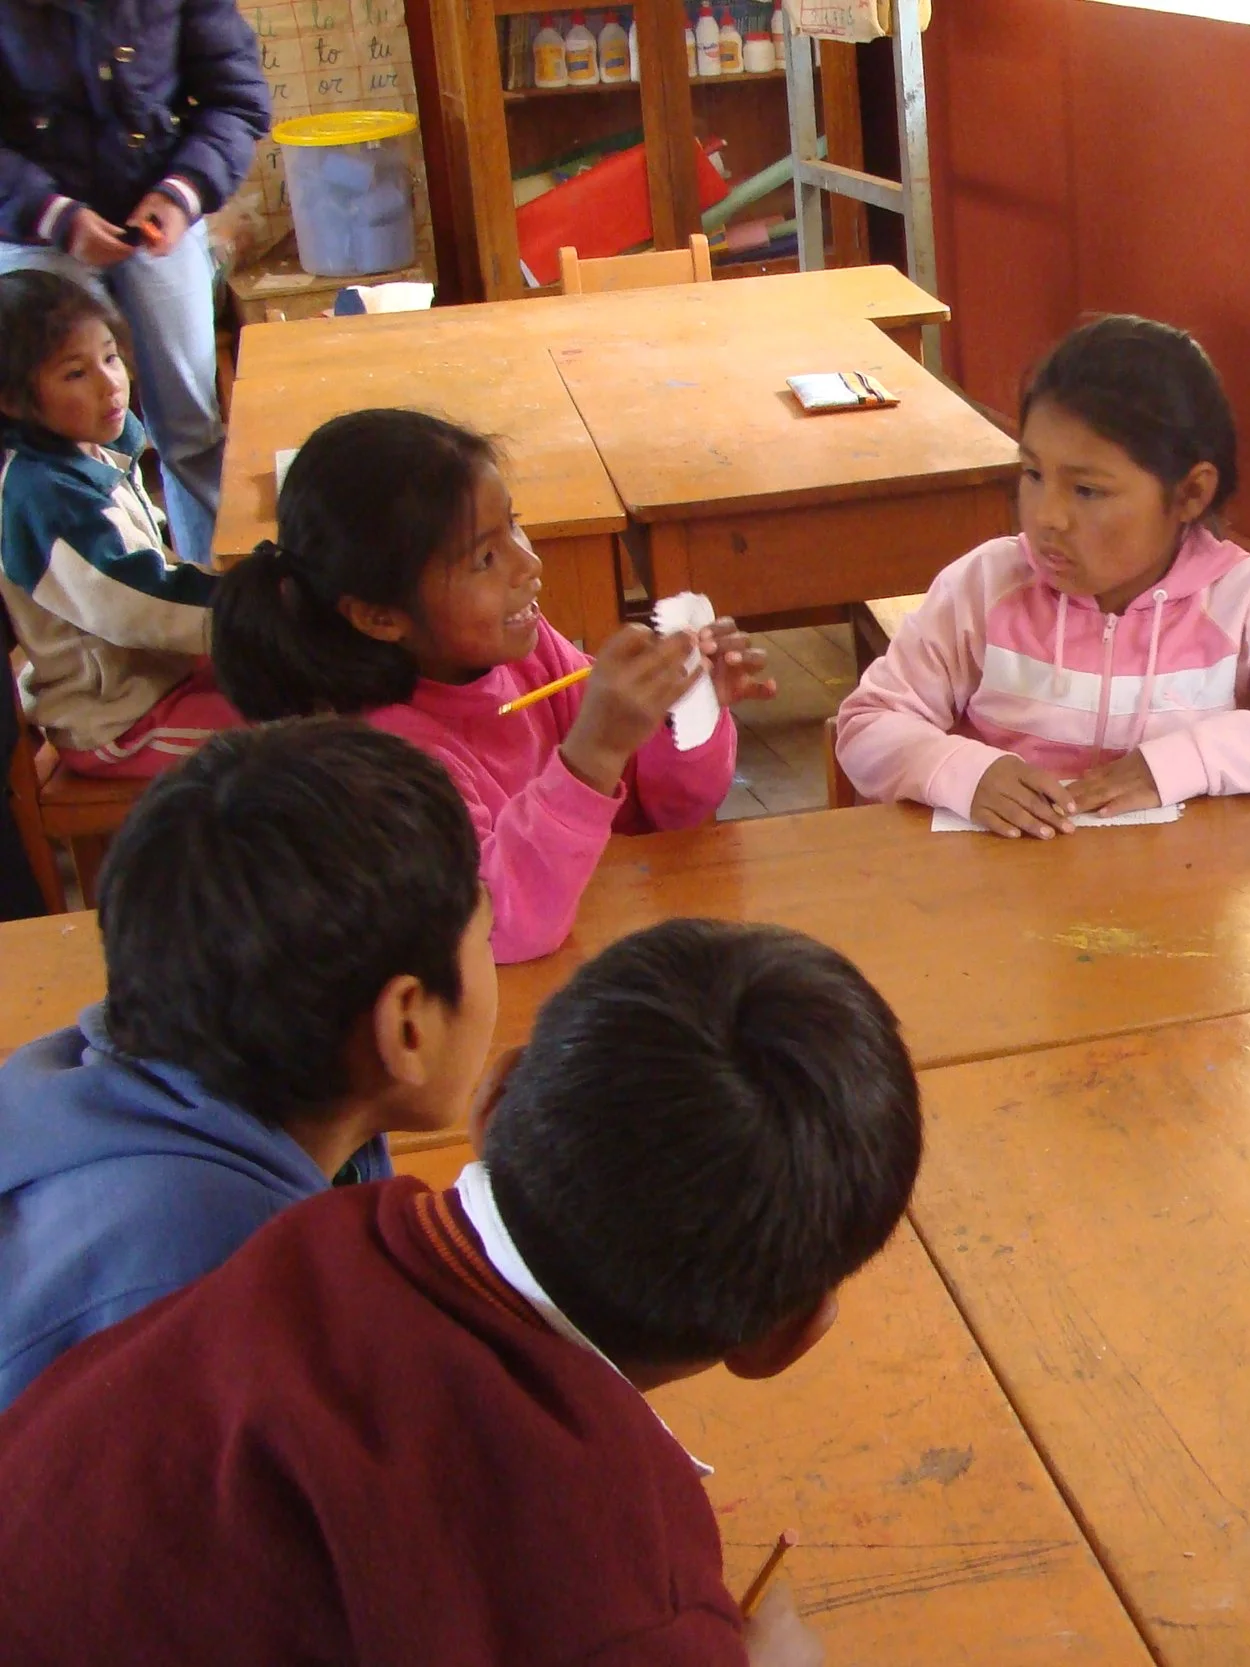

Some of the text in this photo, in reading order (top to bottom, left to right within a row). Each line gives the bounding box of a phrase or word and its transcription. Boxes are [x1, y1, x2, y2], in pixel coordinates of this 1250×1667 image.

[315, 37, 342, 65] to
[368, 36, 392, 61] tu
[318, 77, 343, 95] or
